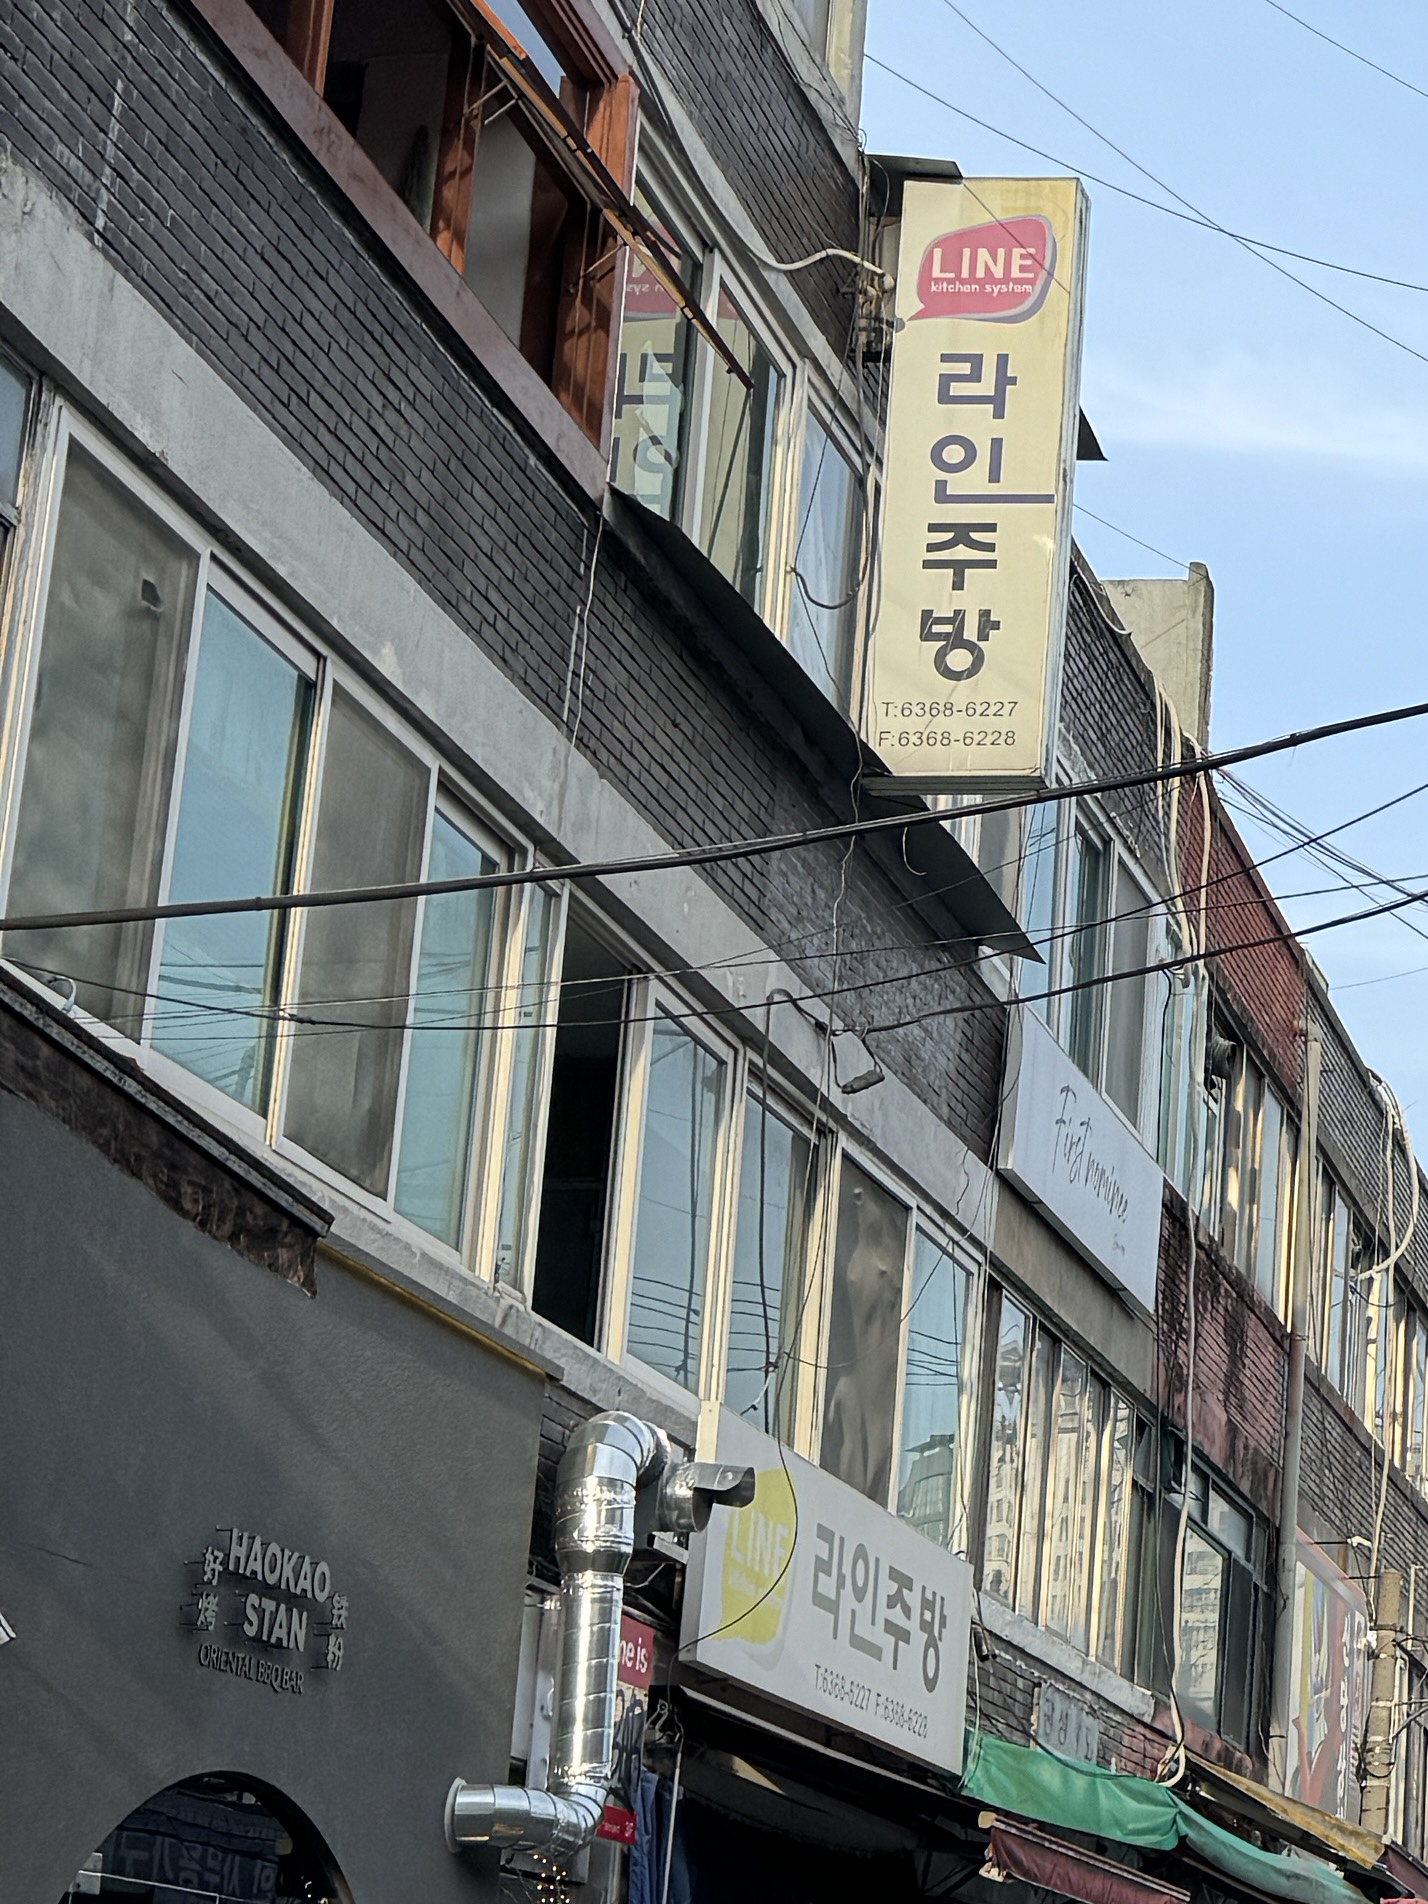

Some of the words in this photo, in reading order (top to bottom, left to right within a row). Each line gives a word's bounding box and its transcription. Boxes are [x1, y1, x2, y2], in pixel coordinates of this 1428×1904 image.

[930, 247, 1037, 280] LINE
[930, 281, 980, 294] kitchen
[984, 281, 1033, 295] system
[919, 351, 1056, 683] 라인주방
[882, 699, 1019, 719] T:6368-6227
[877, 729, 1017, 749] F:6368-6228
[229, 1527, 332, 1604] HAOKAO
[731, 1508, 790, 1581] LINE
[243, 1593, 308, 1653] STAN
[811, 1523, 948, 1694] 라인주방
[200, 1643, 255, 1681] ORIENTAL
[257, 1659, 284, 1694] BBQ
[282, 1668, 304, 1696] BAR
